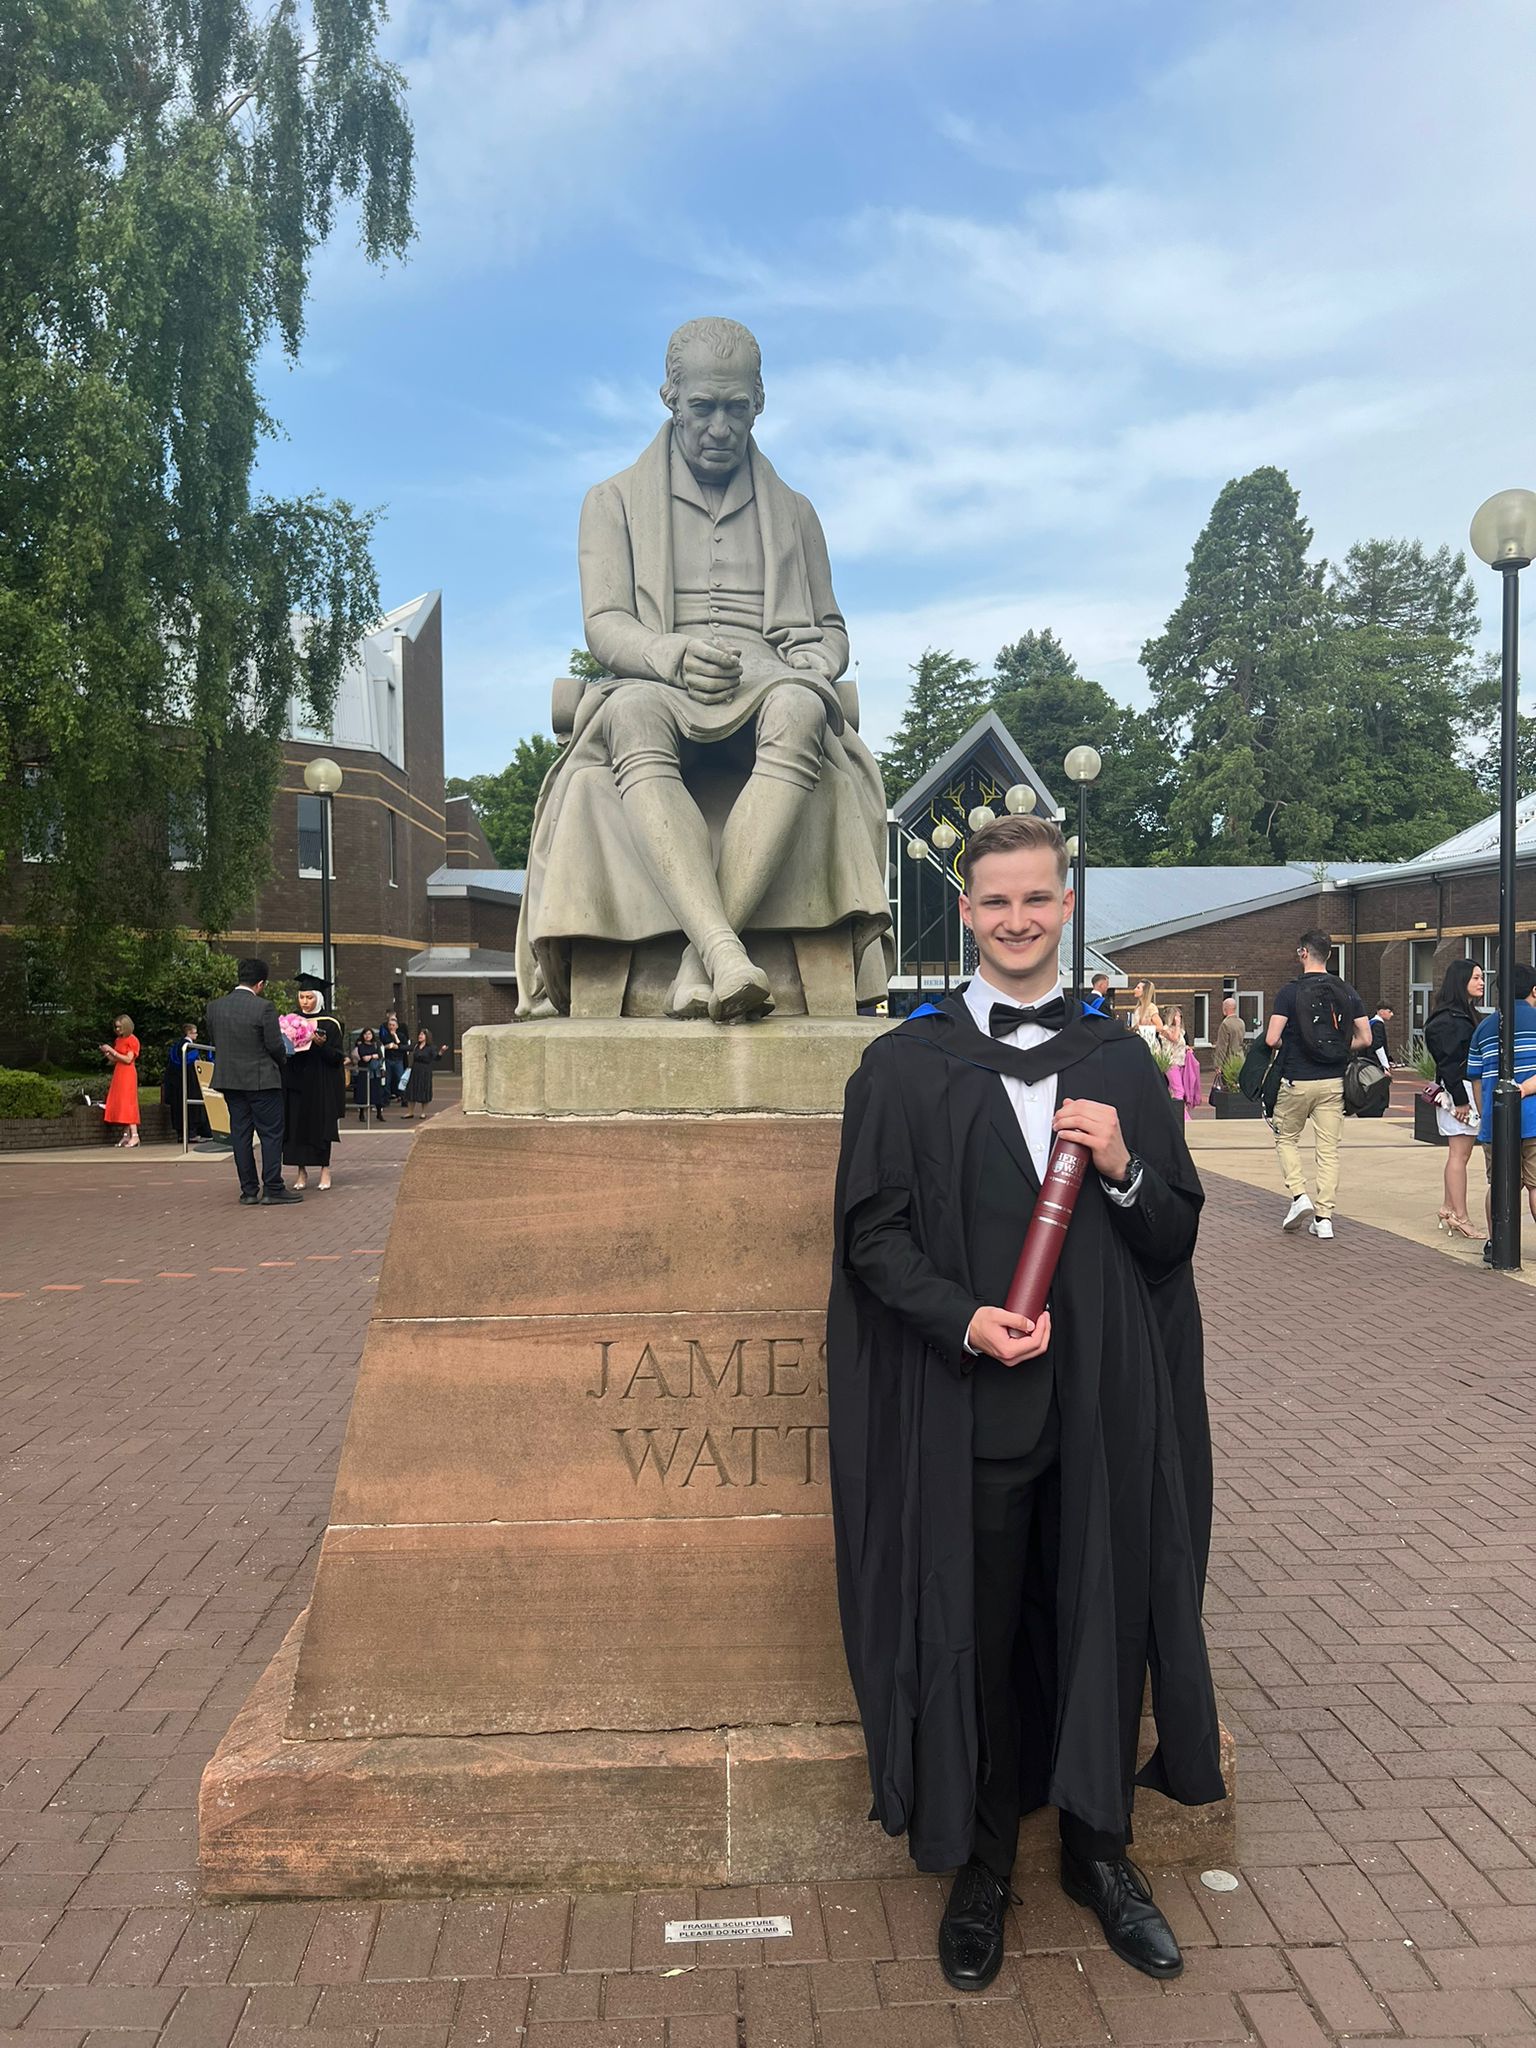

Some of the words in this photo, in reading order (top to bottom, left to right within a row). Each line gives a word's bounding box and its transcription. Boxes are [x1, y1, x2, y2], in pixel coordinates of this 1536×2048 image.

[611, 1426, 828, 1487] WATT
[682, 1922, 720, 1930] FRAGILE
[722, 1919, 775, 1928] SCULPTURE
[679, 1930, 715, 1938] PLEASE
